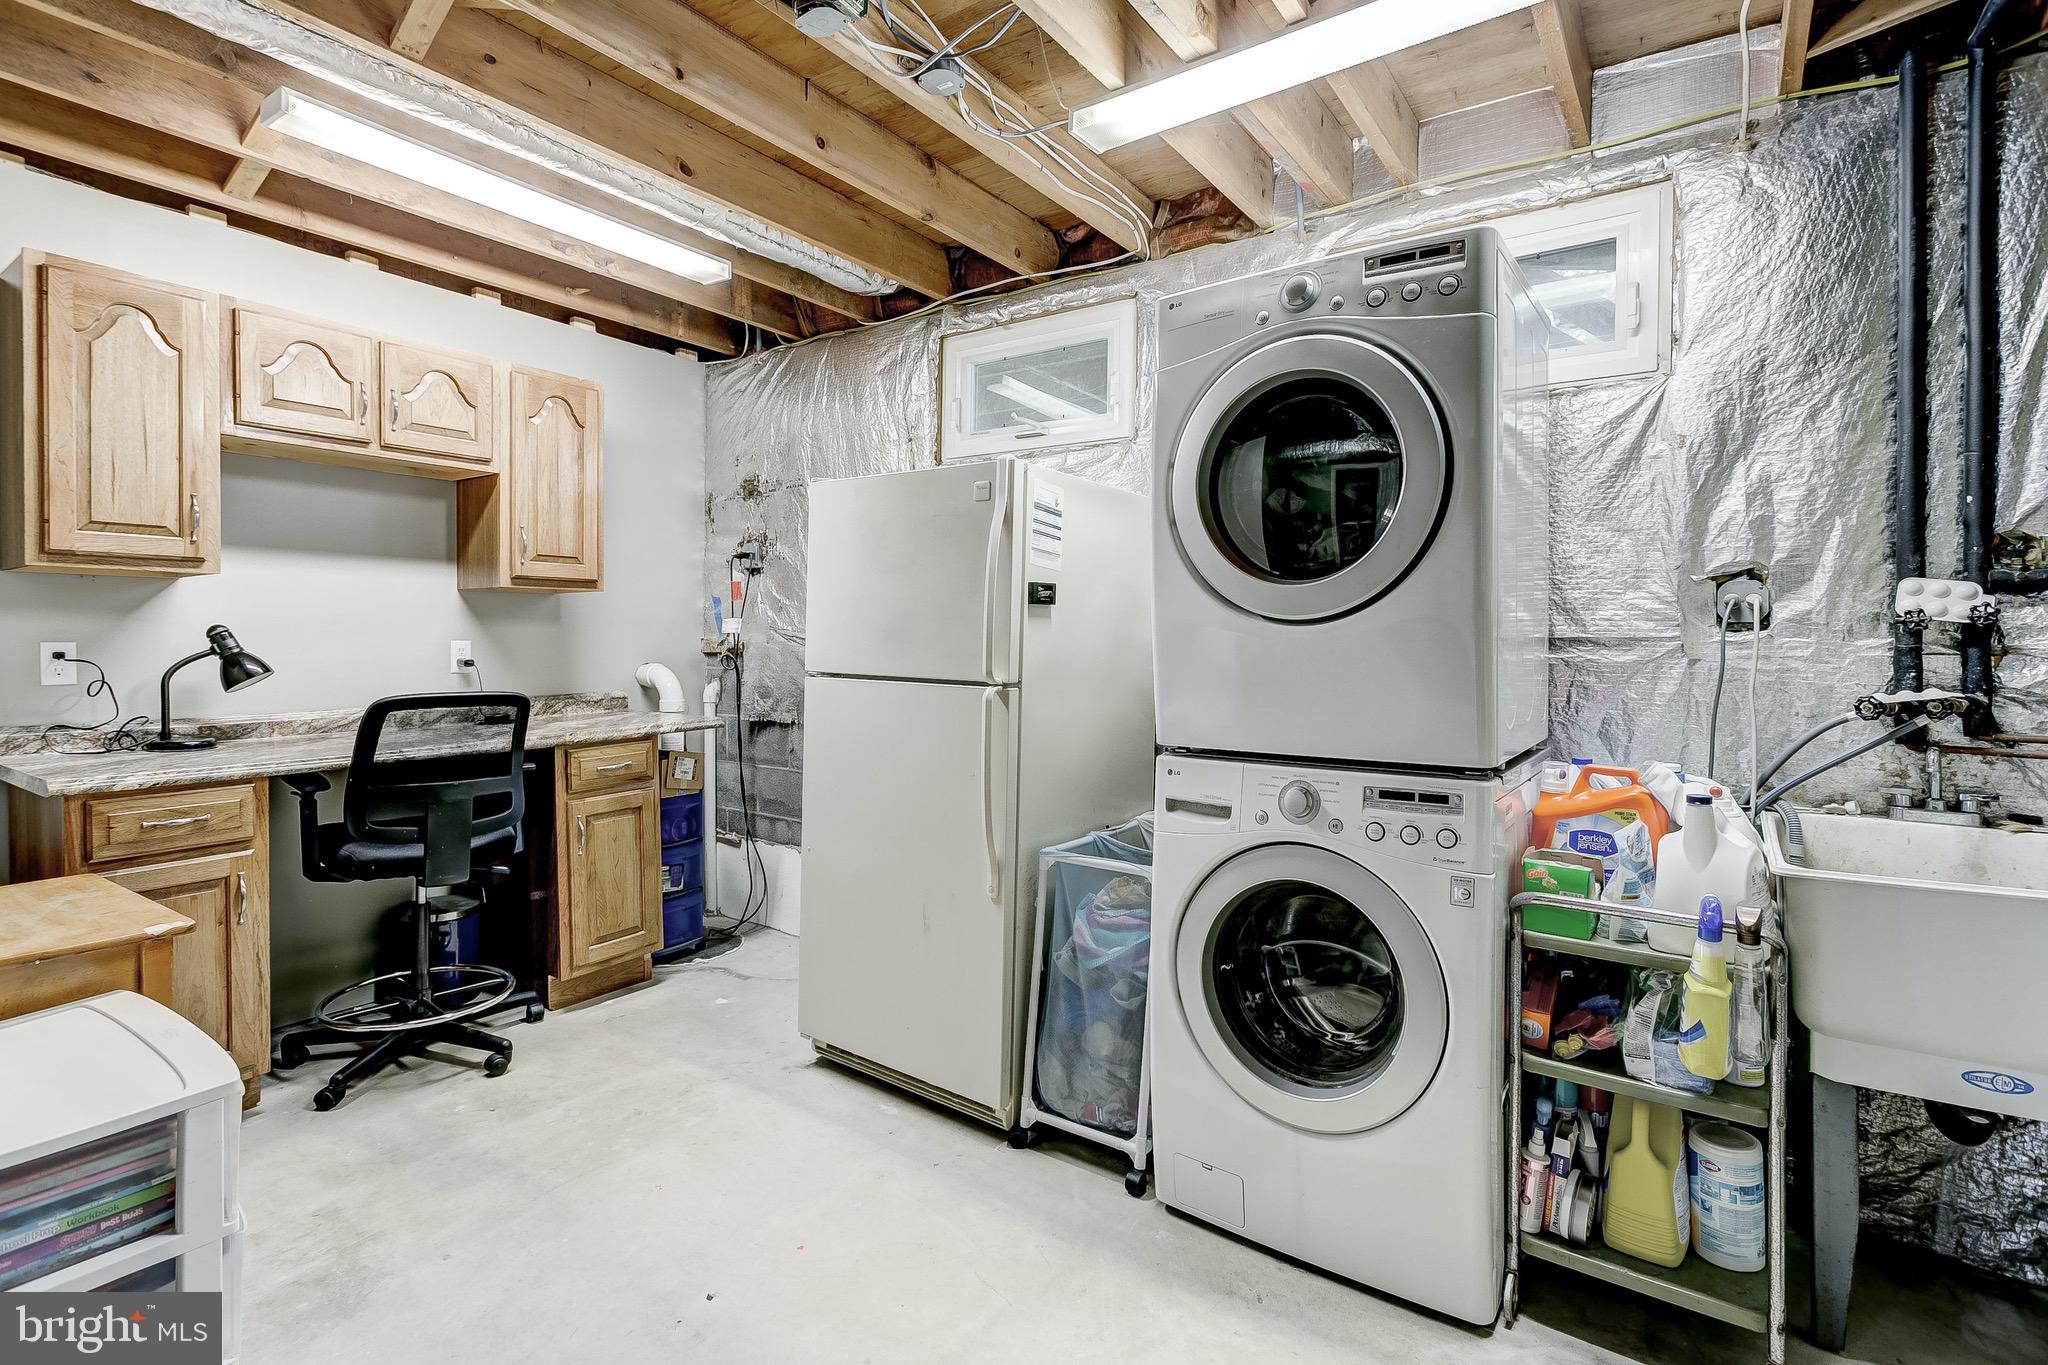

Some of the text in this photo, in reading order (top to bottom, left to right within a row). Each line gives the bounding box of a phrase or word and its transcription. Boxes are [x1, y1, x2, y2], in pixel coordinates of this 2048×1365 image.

[1577, 832, 1613, 845] berkley
[1527, 868, 1548, 879] Gain
[66, 1203, 120, 1228] Workbook
[100, 1215, 121, 1230] Best
[122, 1207, 144, 1222] Buds
